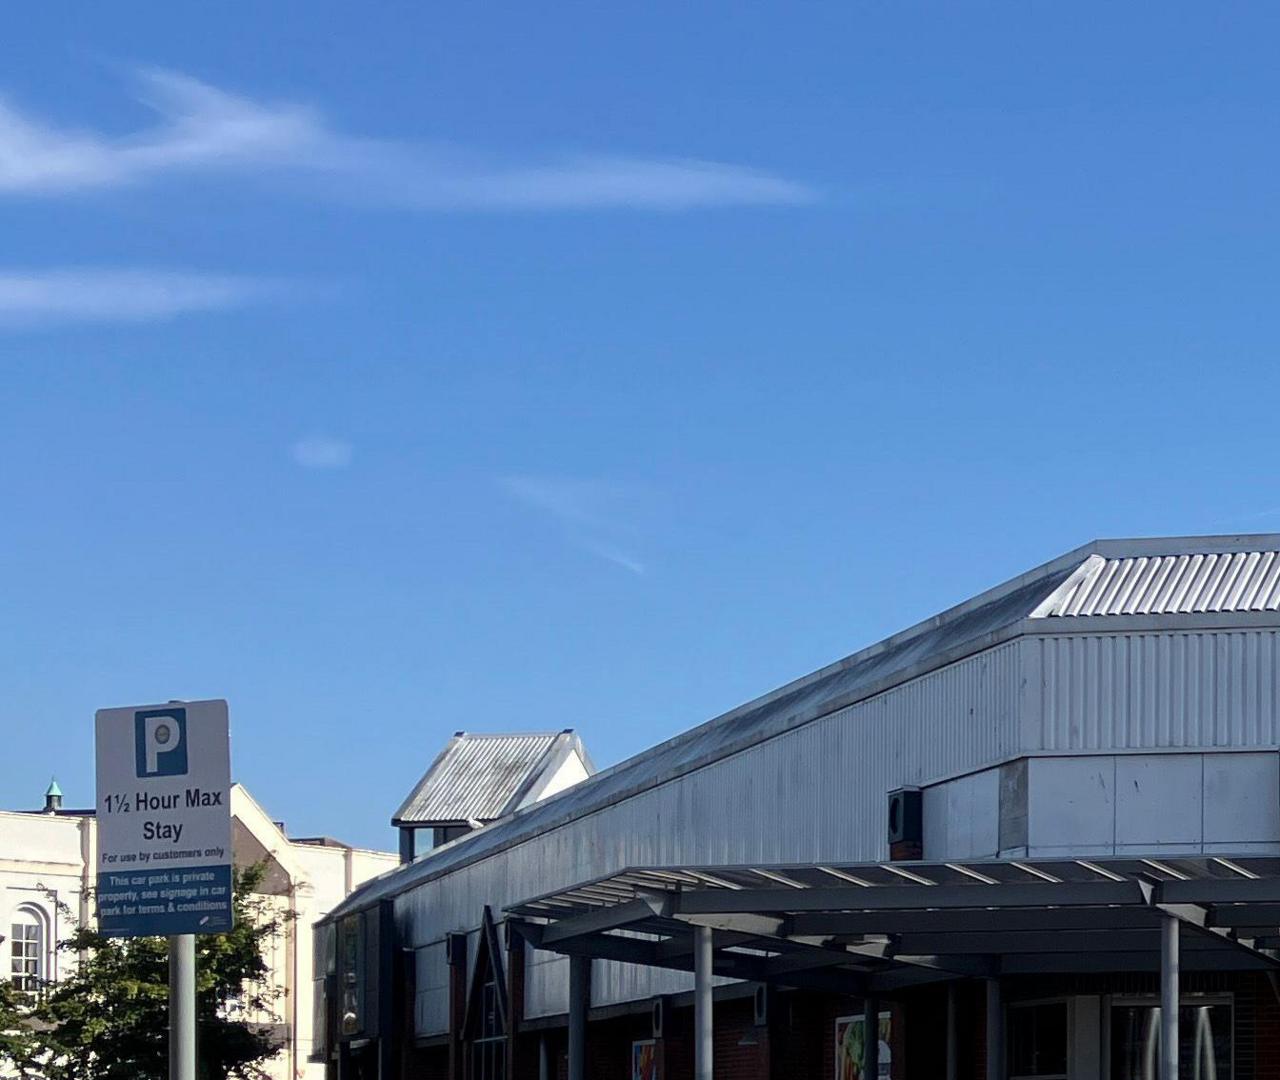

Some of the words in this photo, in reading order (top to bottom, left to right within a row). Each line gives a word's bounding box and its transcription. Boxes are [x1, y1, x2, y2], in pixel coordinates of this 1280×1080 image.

[144, 716, 180, 773] P
[136, 792, 180, 811] Hour
[185, 788, 223, 808] Max
[143, 821, 183, 843] Stay
[102, 853, 118, 864] For
[120, 854, 136, 862] use
[139, 851, 151, 863] by
[153, 848, 202, 860] customers
[204, 847, 224, 858] only
[109, 875, 129, 886] This
[131, 877, 146, 885] car
[148, 874, 168, 887] park
[171, 874, 180, 883] is
[182, 872, 215, 885] private
[141, 891, 158, 899] see
[160, 888, 198, 900] signage
[211, 886, 226, 895] car
[100, 905, 120, 919] park
[123, 905, 136, 914] for
[138, 904, 165, 914] terms
[177, 900, 228, 912] conditions
